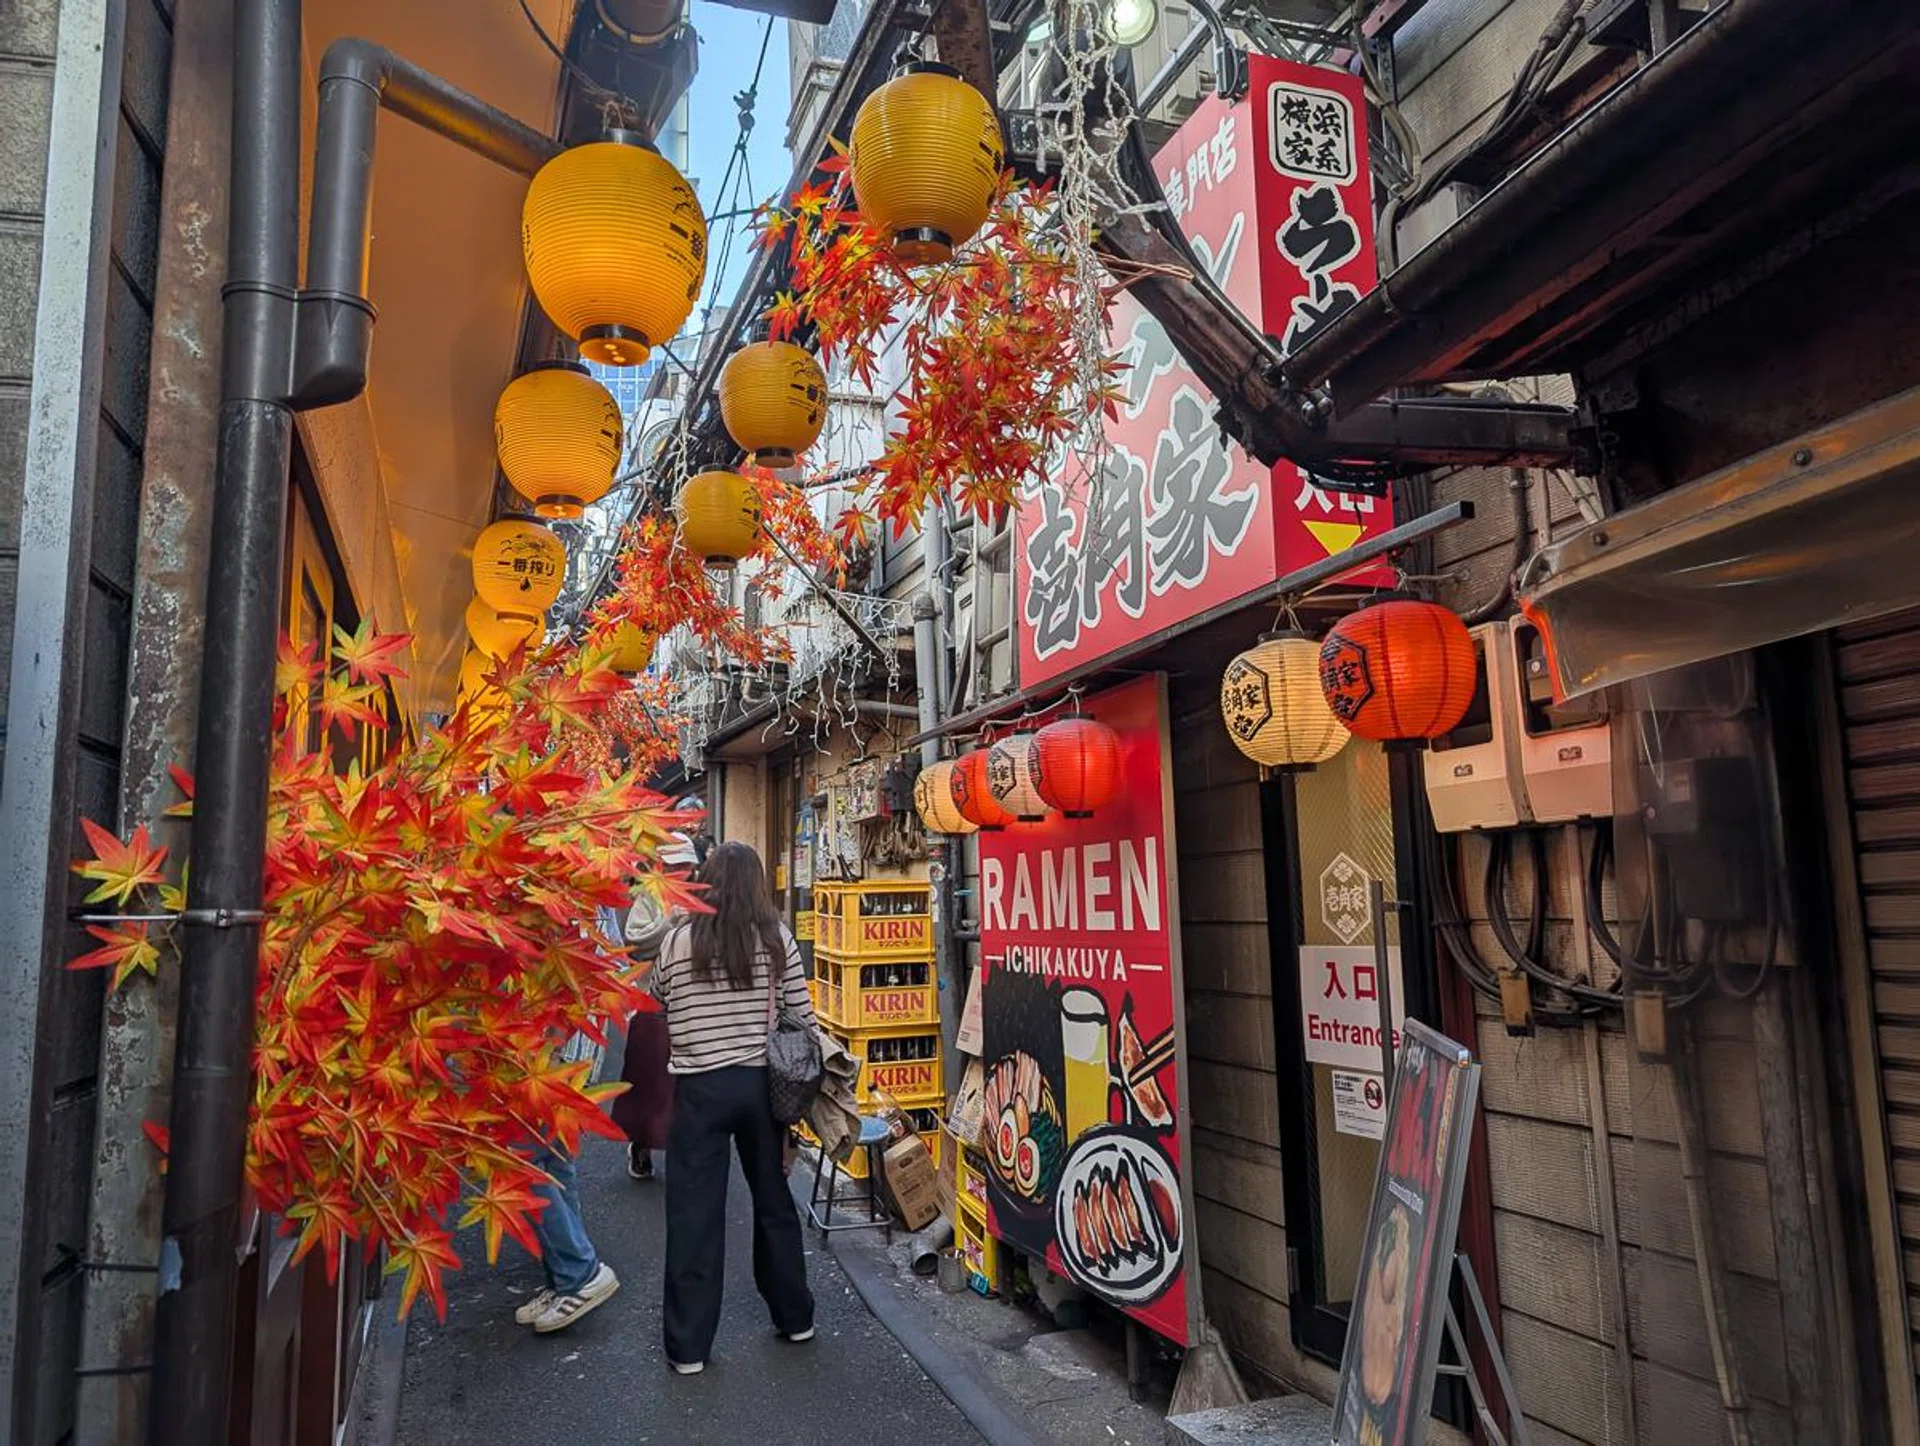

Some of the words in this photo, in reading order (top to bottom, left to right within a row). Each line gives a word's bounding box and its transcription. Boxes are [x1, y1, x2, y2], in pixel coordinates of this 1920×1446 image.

[1281, 95, 1343, 138] 横浜
[1283, 132, 1342, 173] 家系
[497, 557, 555, 577] 一番搾り
[982, 836, 1161, 931] RAMEN
[1326, 884, 1365, 912] 壱角家
[863, 920, 923, 940] KIRIN
[1005, 945, 1127, 982] ICHIKAKUYA
[1323, 961, 1377, 1001] 入口
[865, 992, 925, 1013] KIRIN
[872, 1065, 932, 1087] KIRIN
